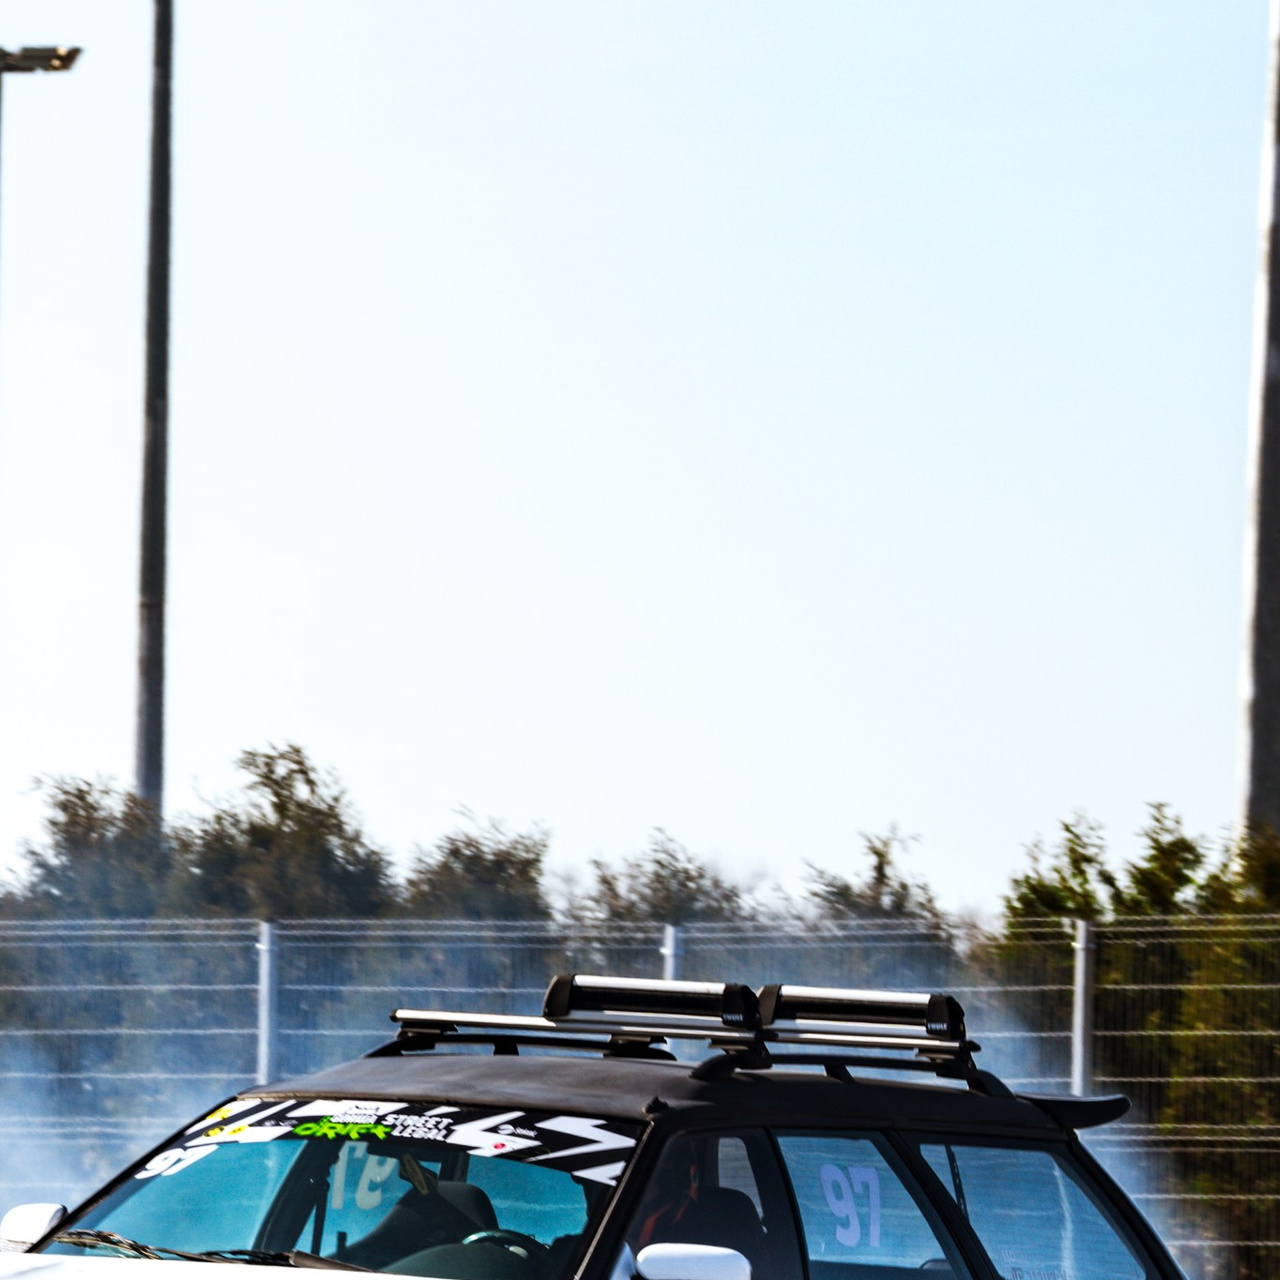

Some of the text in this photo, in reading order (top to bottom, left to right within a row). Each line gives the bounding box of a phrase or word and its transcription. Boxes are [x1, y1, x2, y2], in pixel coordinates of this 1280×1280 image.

[381, 1113, 453, 1129] STREET
[391, 1125, 449, 1141] LEGAL
[134, 1144, 219, 1180] 97
[821, 1163, 881, 1249] 97
